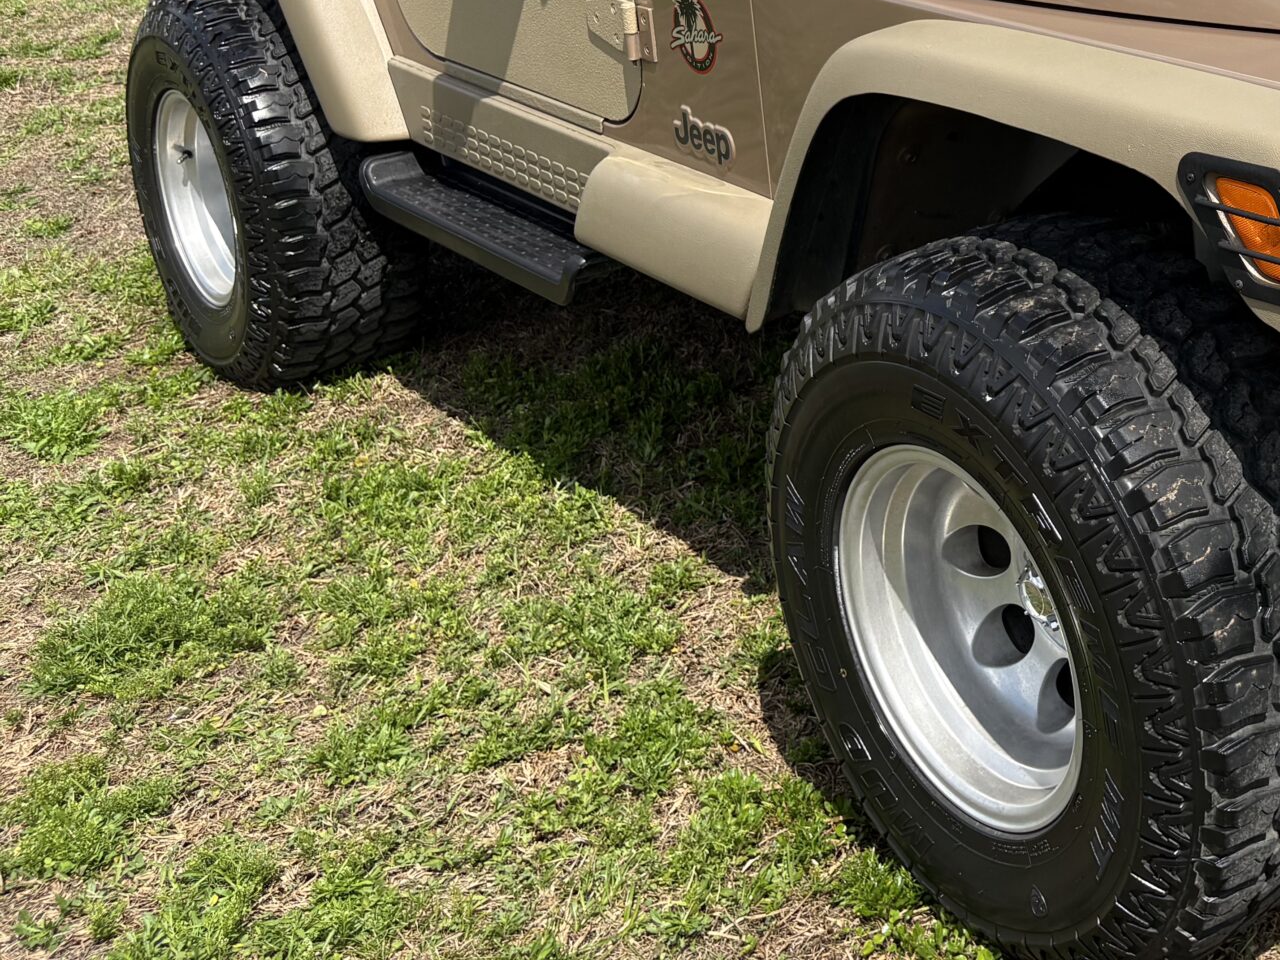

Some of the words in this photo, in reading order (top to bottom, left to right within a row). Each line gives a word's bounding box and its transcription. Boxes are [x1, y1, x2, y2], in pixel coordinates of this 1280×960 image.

[670, 23, 723, 49] Sahara
[673, 110, 731, 166] Jeep
[910, 383, 1125, 756] EXTREME
